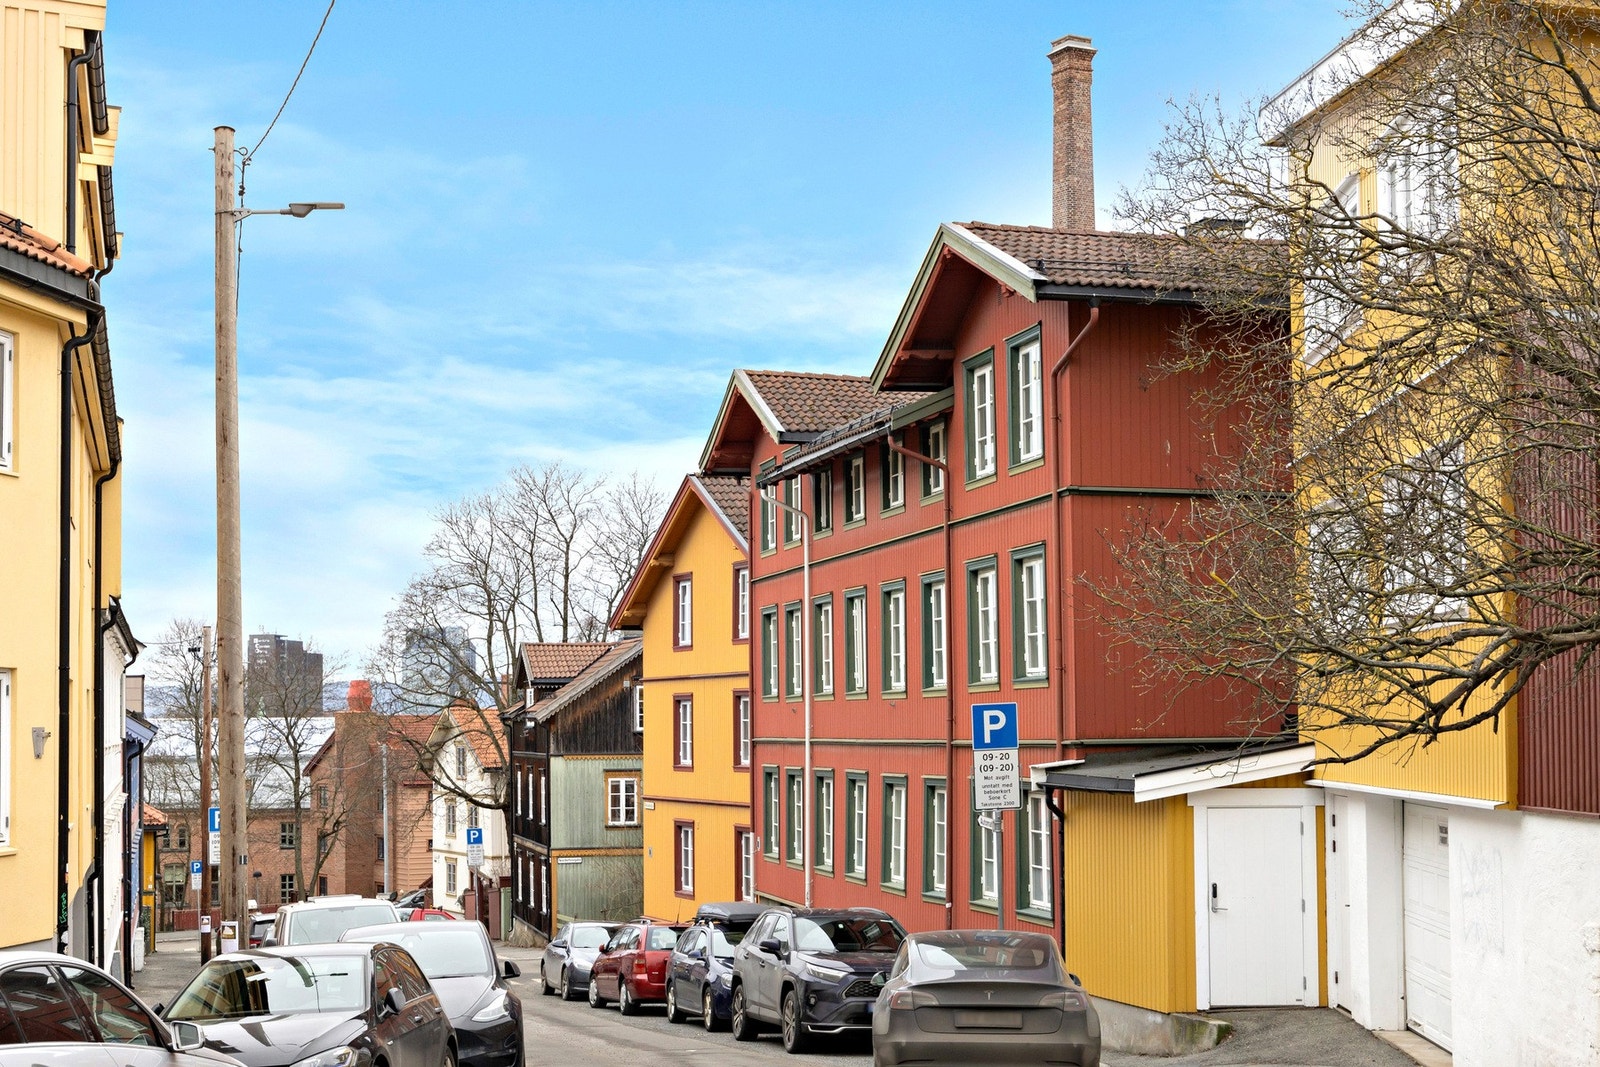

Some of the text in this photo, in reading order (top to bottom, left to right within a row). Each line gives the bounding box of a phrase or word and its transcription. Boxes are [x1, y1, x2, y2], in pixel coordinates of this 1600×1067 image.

[983, 709, 1006, 744] P
[470, 830, 479, 843] P
[193, 862, 201, 873] P
